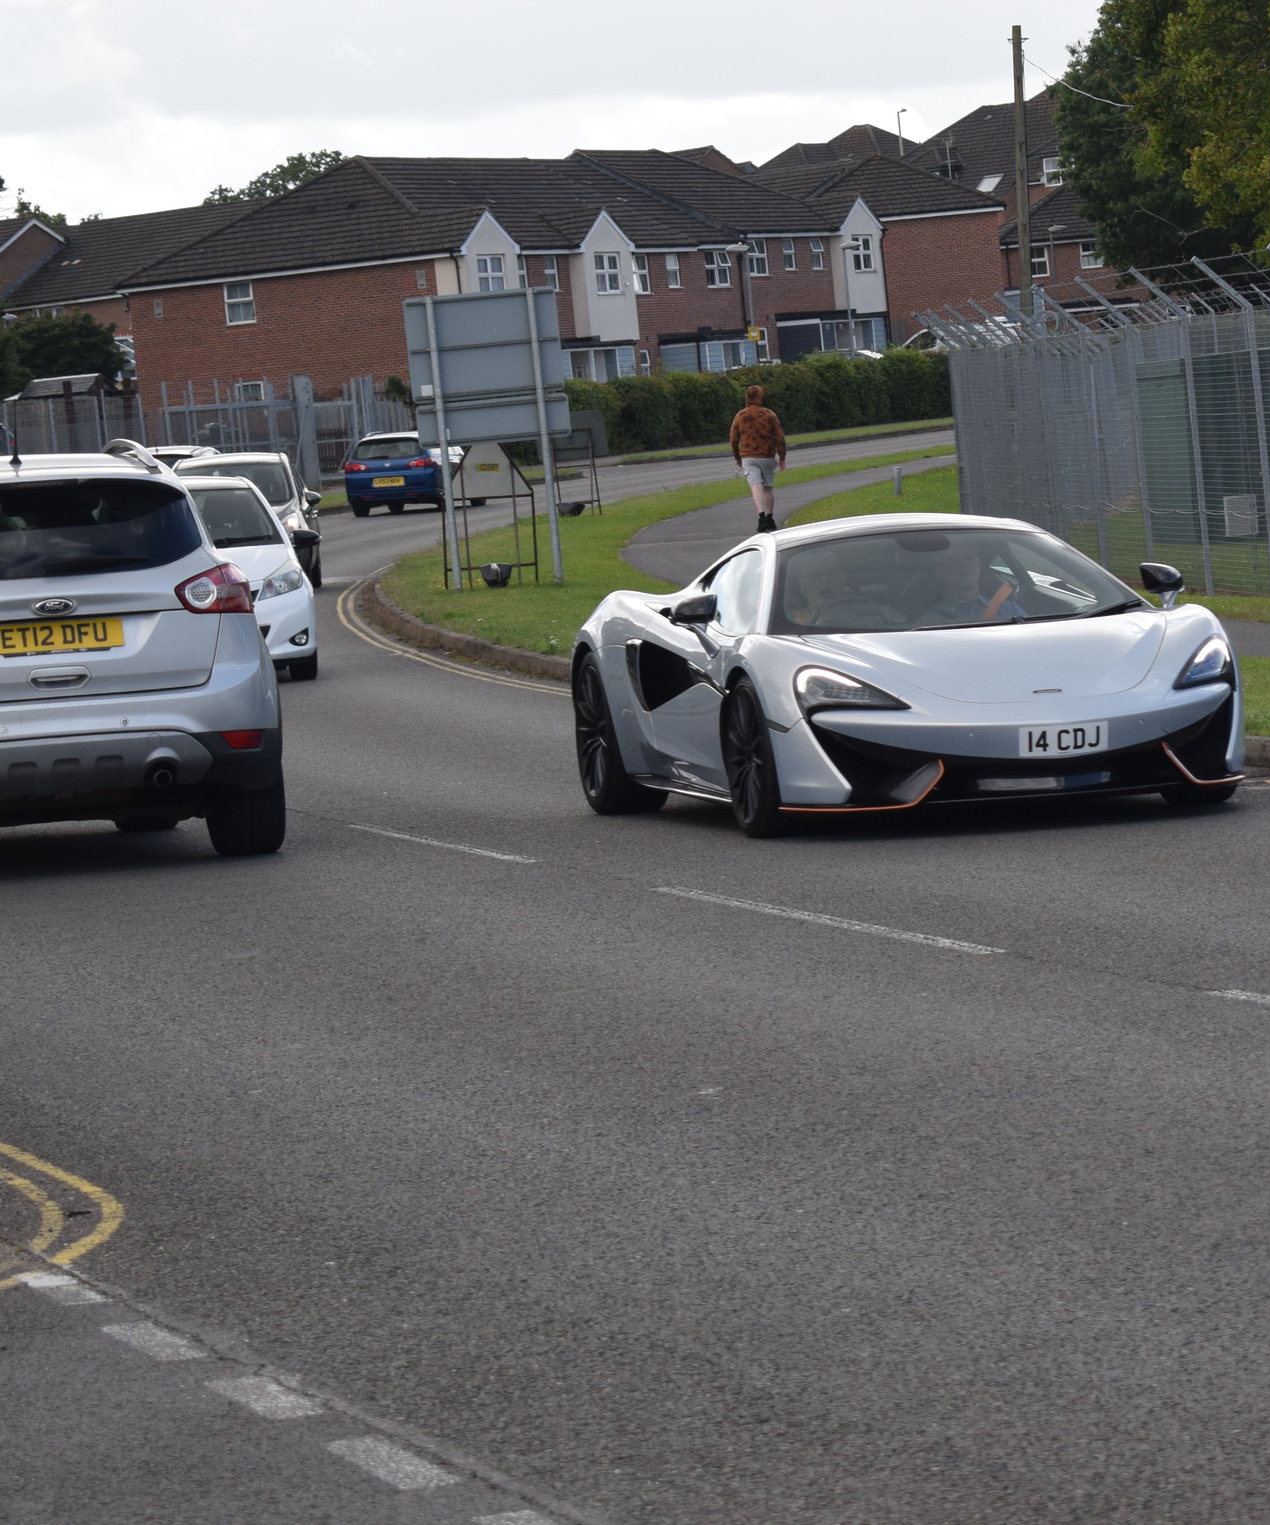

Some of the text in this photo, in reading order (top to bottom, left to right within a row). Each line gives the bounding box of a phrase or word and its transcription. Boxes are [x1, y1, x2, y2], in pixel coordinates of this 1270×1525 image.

[44, 601, 65, 610] Ford
[1, 622, 108, 649] ET12 DFU
[1028, 725, 1100, 752] 14 CDJ
